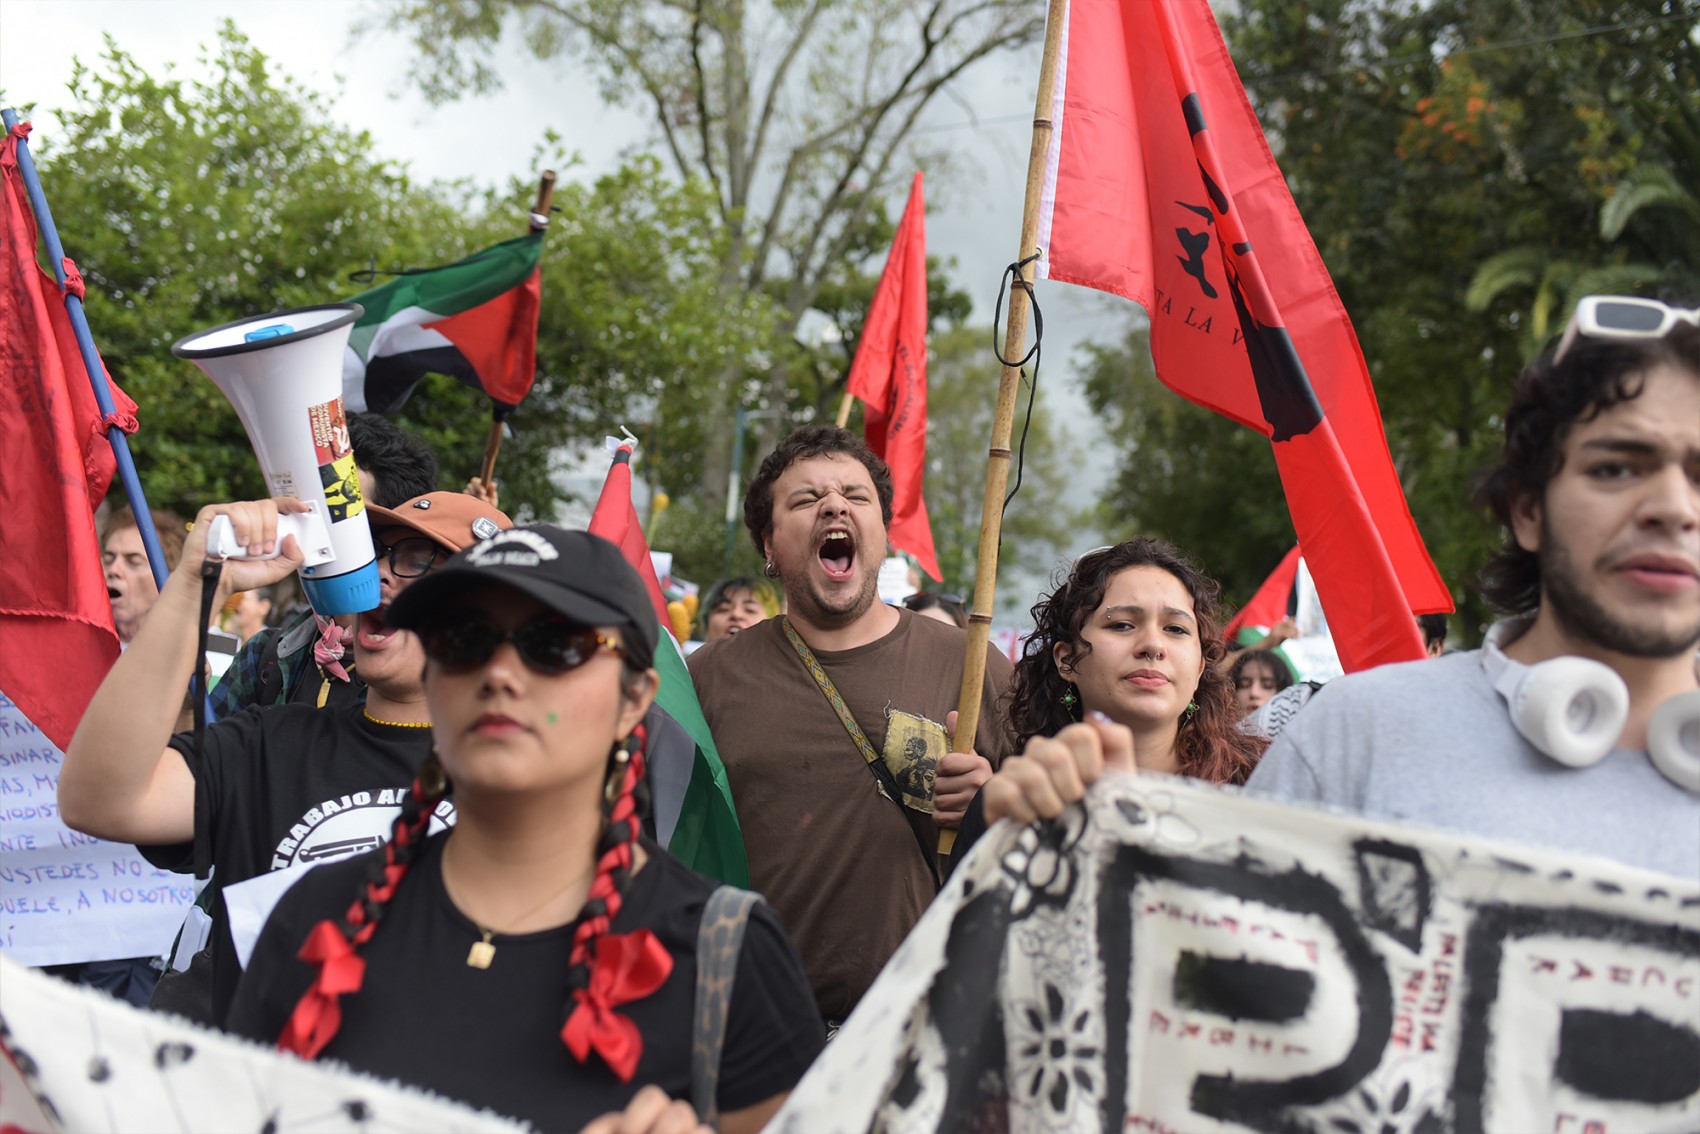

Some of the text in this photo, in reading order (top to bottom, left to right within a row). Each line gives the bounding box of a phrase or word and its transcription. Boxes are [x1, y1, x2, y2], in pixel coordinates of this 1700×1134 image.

[1184, 306, 1213, 334] LA
[1232, 327, 1248, 346] V
[0, 803, 60, 821] IODIST
[271, 791, 371, 871] TRABAJO
[0, 863, 99, 885] USTEDES
[111, 858, 142, 877] NO
[78, 889, 91, 910] A
